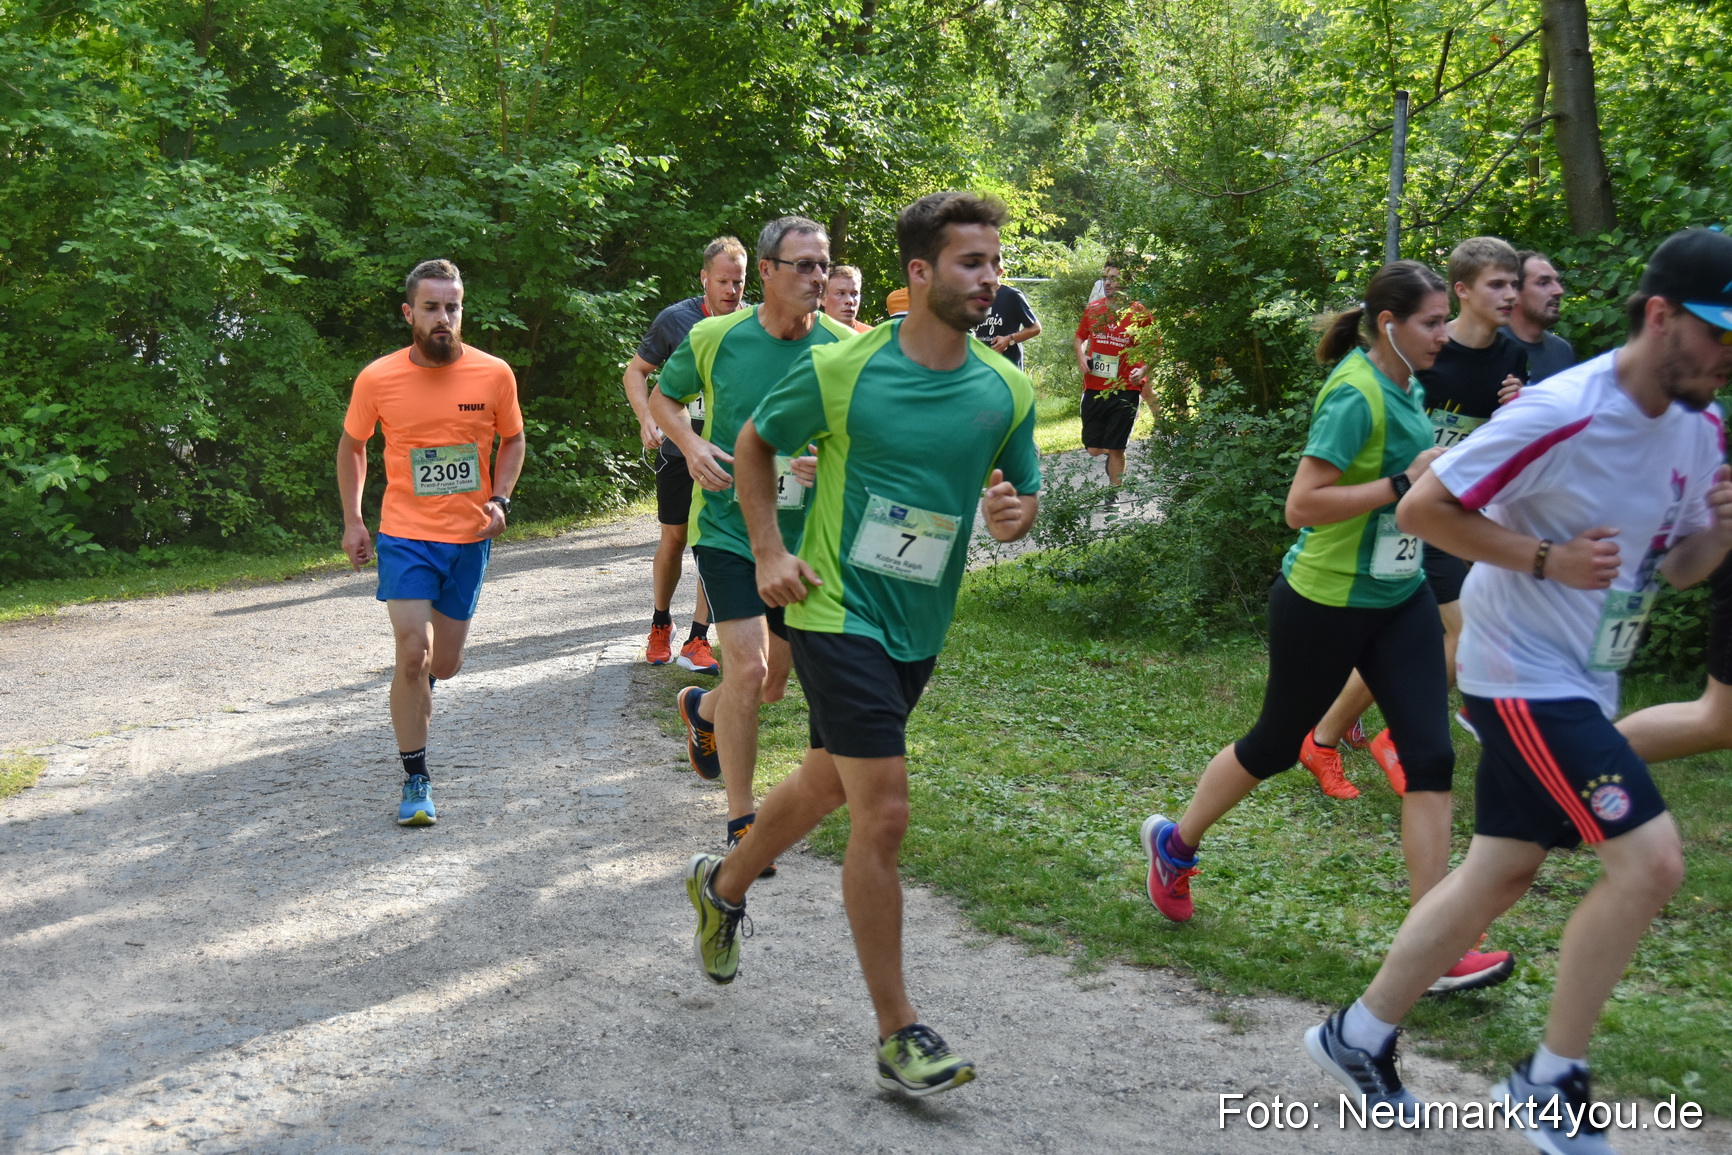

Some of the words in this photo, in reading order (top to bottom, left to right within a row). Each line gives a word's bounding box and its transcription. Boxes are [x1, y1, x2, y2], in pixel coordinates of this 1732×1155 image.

[1094, 362, 1110, 372] 601
[420, 462, 470, 482] 2309
[897, 533, 918, 558] 7
[1395, 537, 1418, 561] 23
[875, 553, 902, 566] Kobras
[903, 560, 923, 570] Ralph
